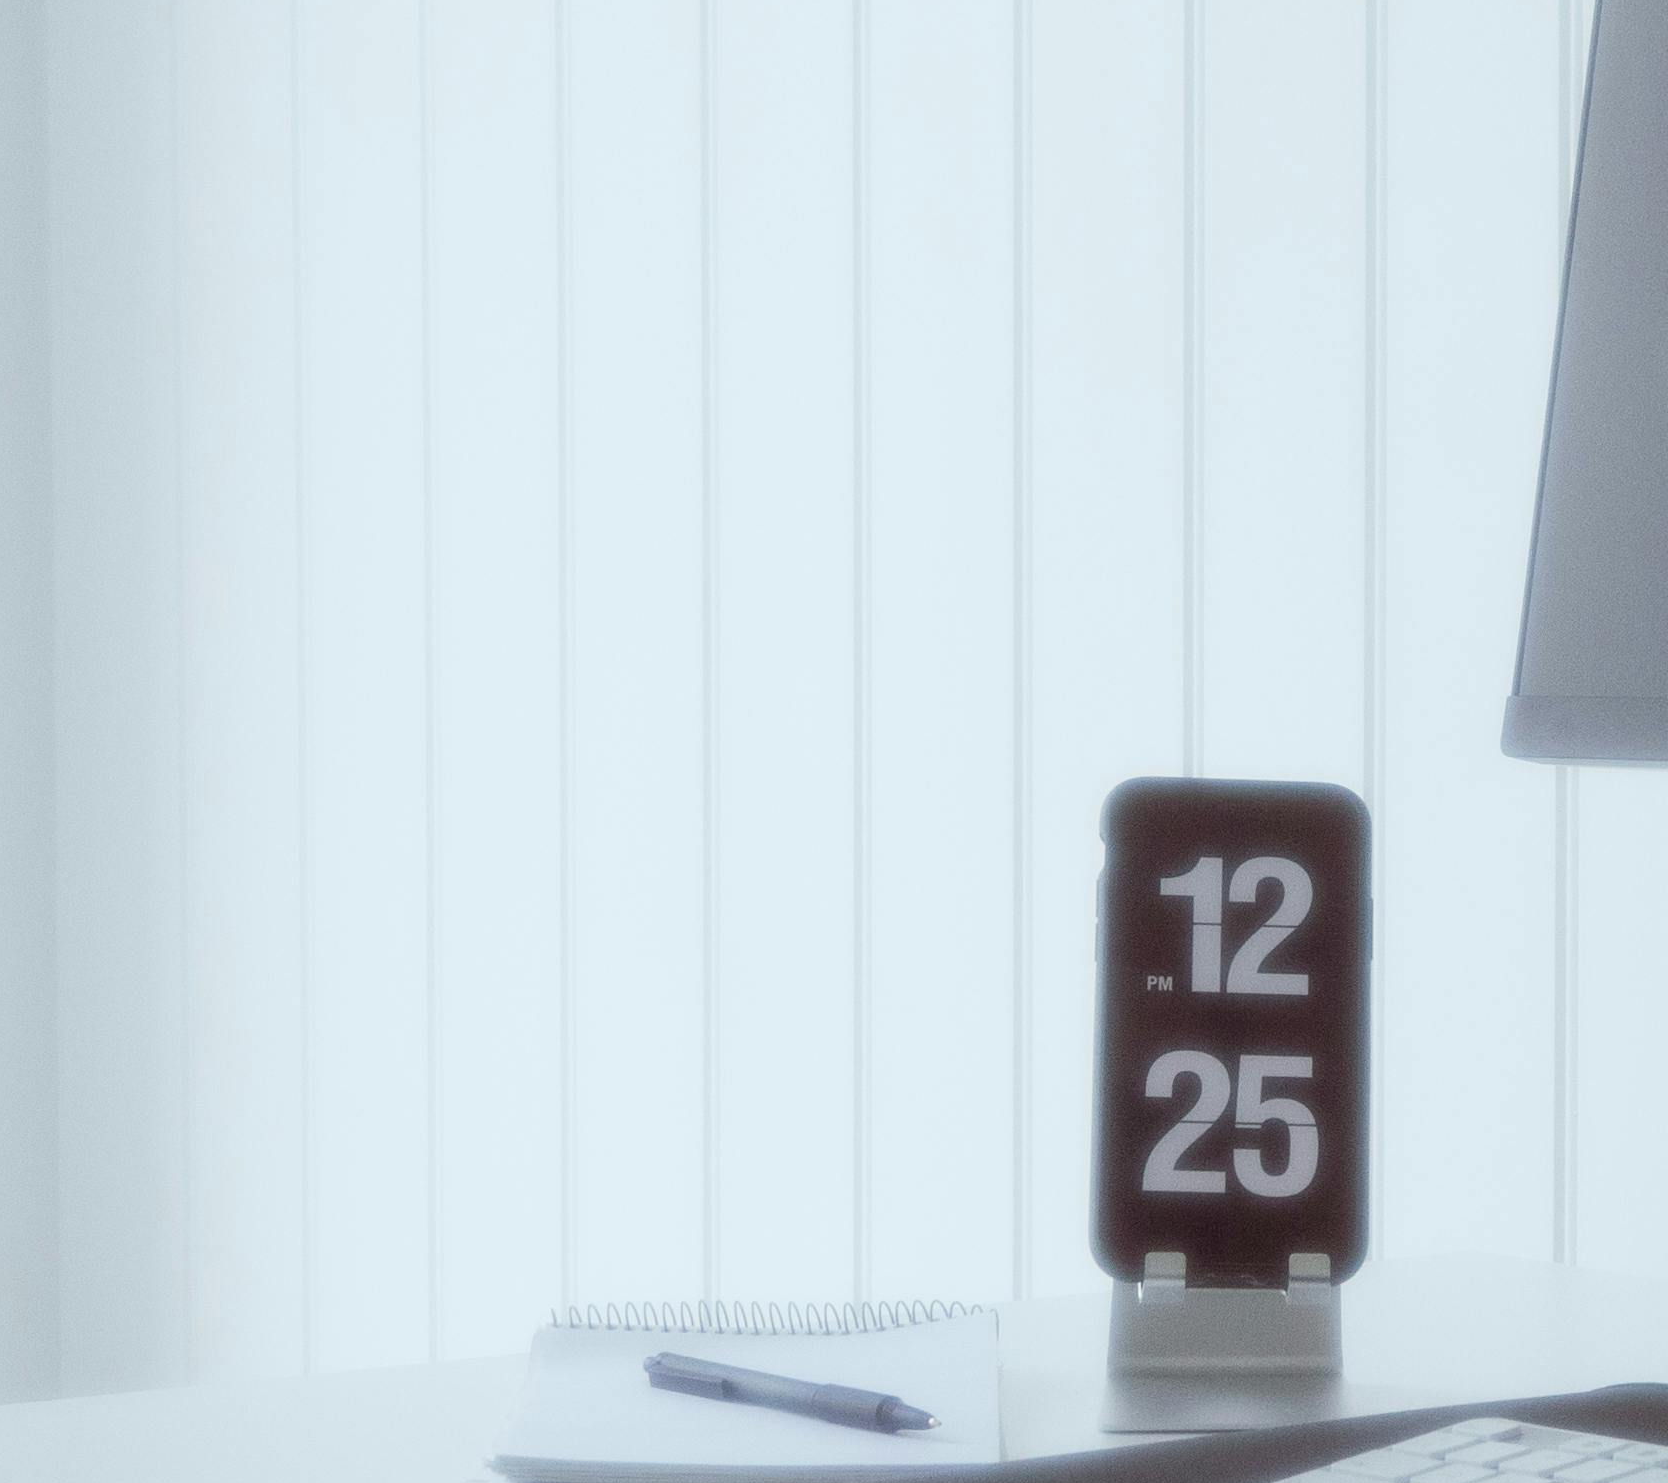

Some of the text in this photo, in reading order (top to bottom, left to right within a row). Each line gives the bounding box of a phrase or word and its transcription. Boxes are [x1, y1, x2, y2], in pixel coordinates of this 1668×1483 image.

[1147, 857, 1313, 995] PM 12
[1143, 1050, 1319, 1197] 25
